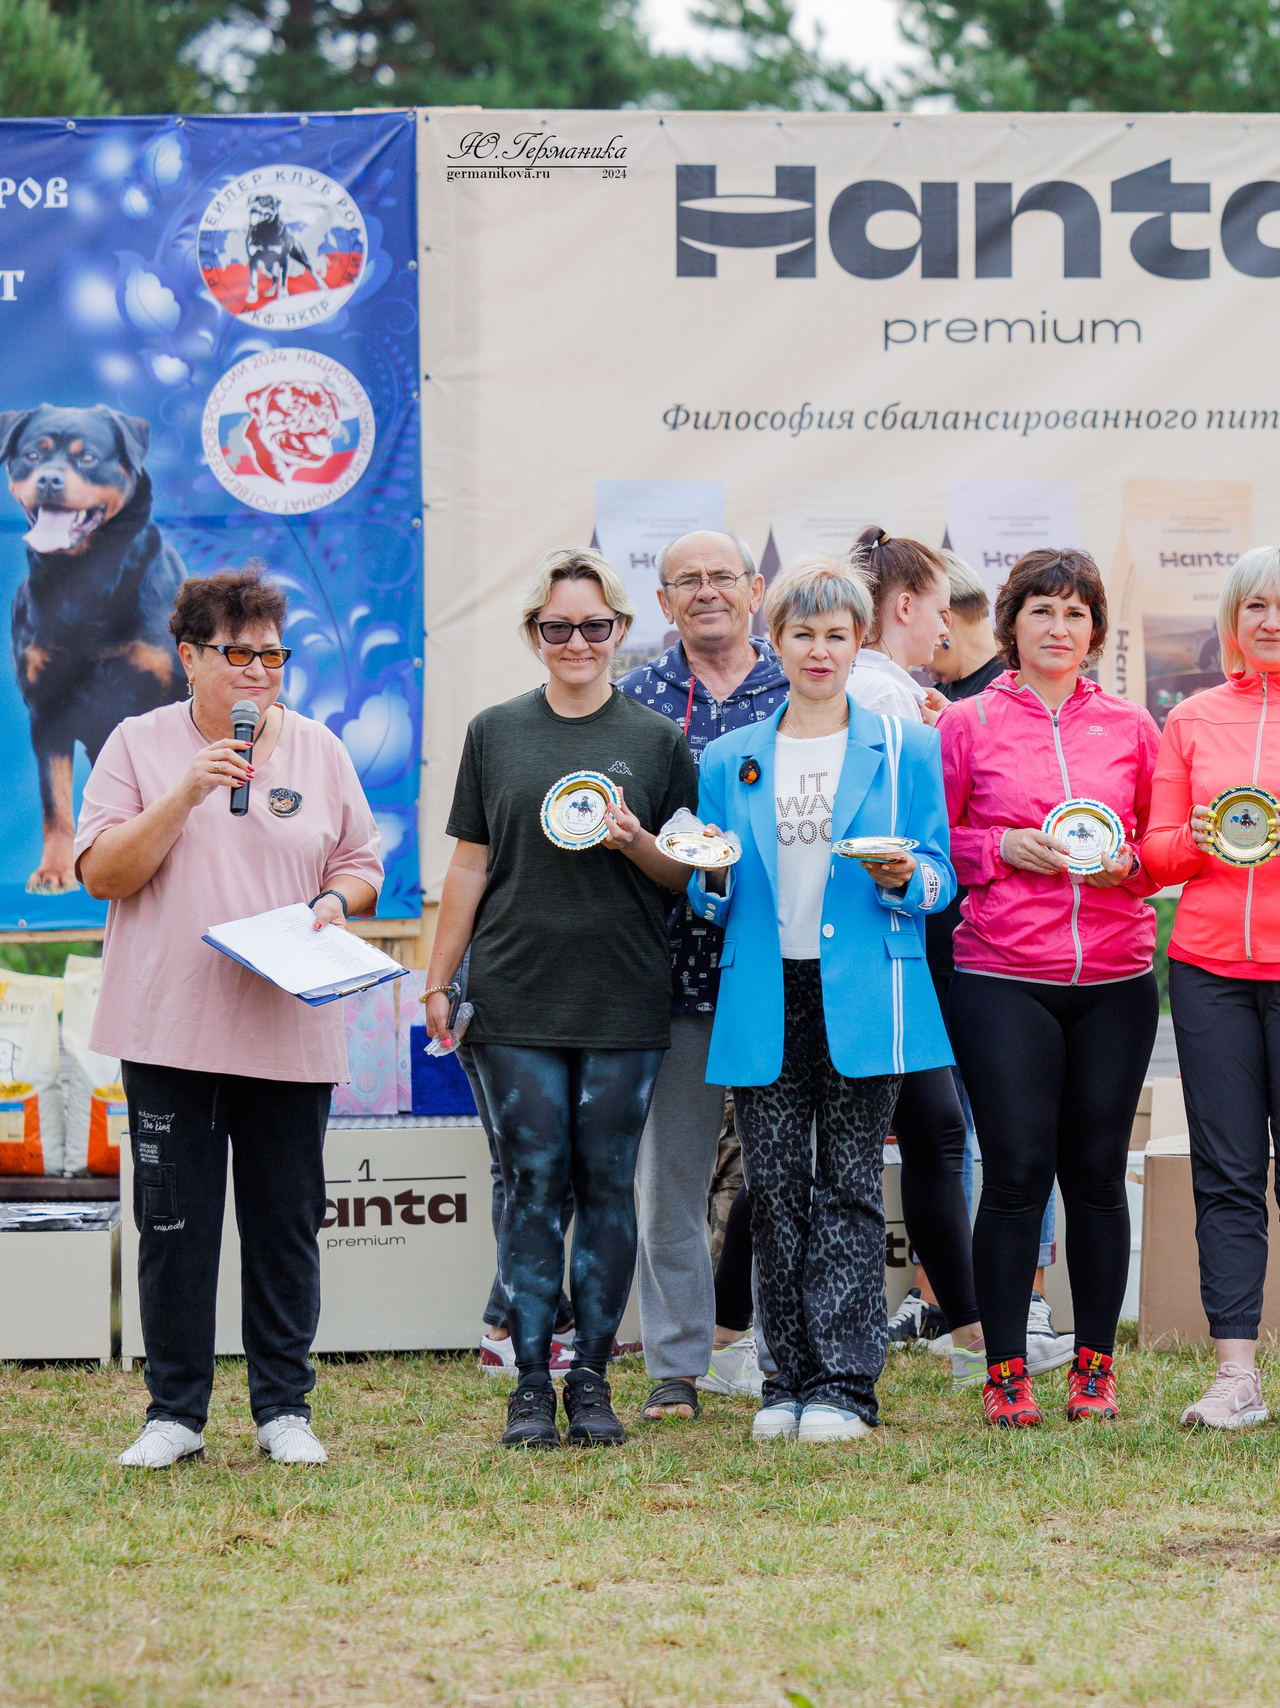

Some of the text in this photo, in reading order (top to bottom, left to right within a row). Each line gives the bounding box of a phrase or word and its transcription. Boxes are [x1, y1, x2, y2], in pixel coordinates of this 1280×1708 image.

[276, 170, 331, 195] КЛУБ
[884, 310, 1143, 350] premium
[206, 365, 249, 422] РОССИИ
[251, 352, 287, 370] 2024
[663, 402, 854, 437] Философия
[864, 402, 1197, 437] сбалансированного
[799, 772, 828, 794] IT
[776, 794, 836, 818] WA
[358, 1159, 376, 1182] 1
[320, 1188, 467, 1229] anta
[326, 1234, 406, 1250] premium
